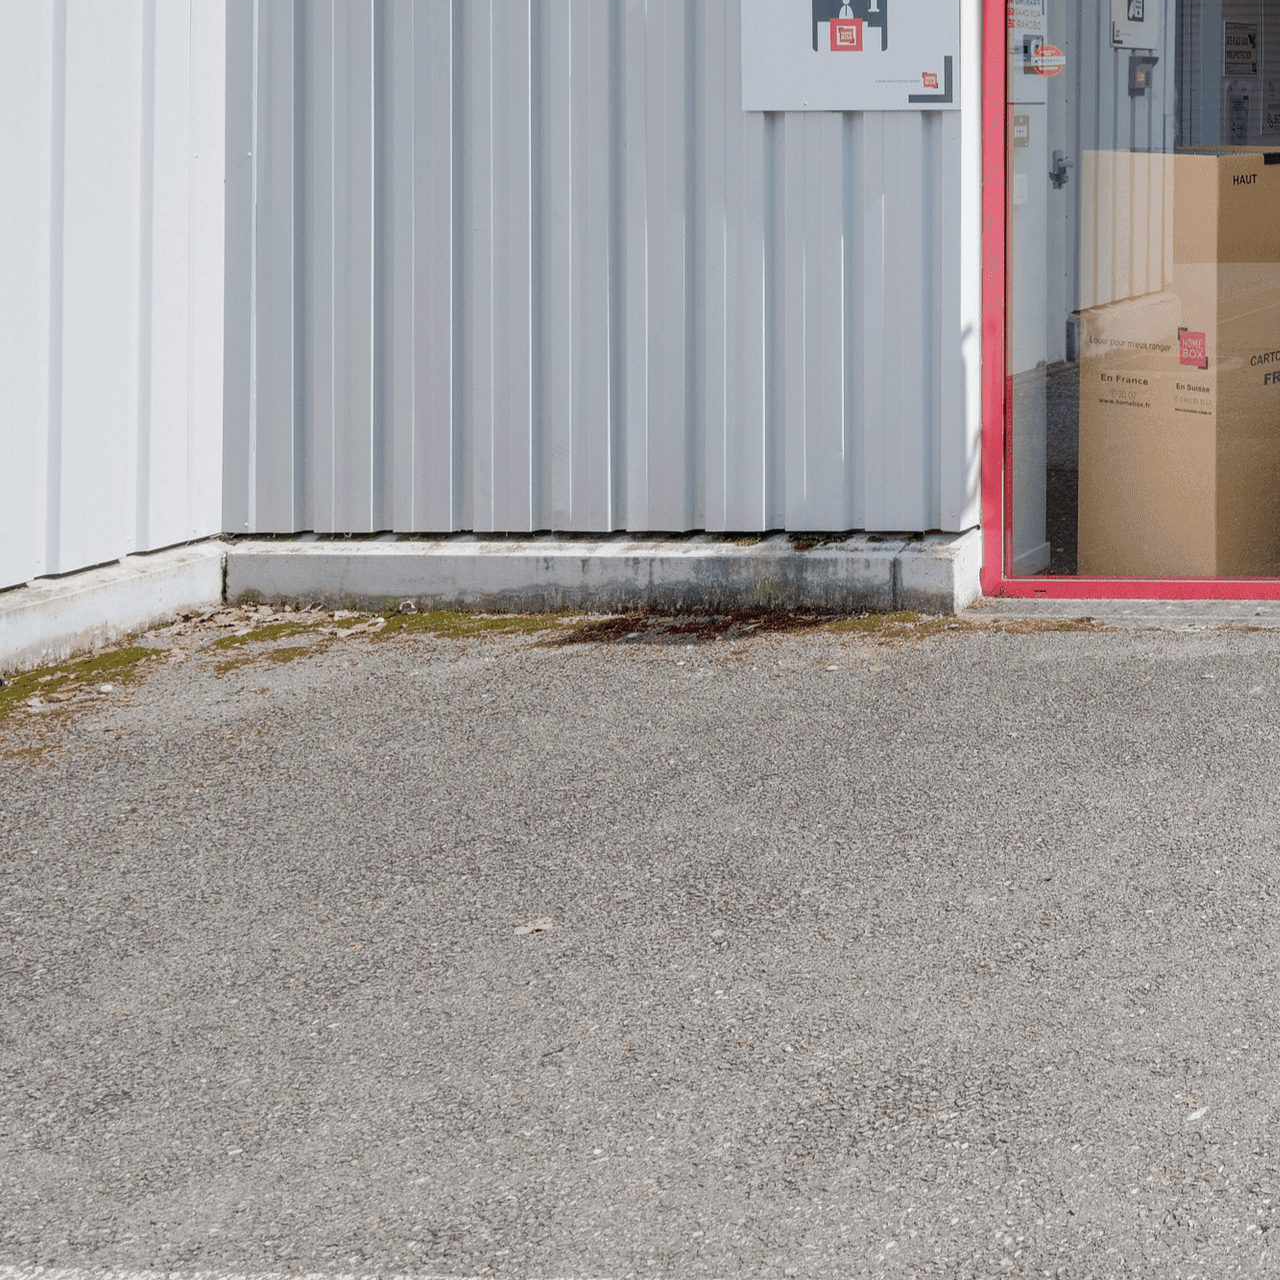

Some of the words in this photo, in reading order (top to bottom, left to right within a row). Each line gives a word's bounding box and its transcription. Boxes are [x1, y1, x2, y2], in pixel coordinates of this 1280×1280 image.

[1233, 174, 1257, 185] HAUT
[1089, 336, 1108, 345] Louer
[1110, 339, 1126, 348] pour
[1127, 340, 1148, 349] mieux
[1149, 343, 1171, 352] ranger
[1182, 339, 1203, 349] HOME
[1182, 348, 1203, 359] BOX
[1100, 374, 1113, 382] En
[1116, 375, 1149, 386] France
[1187, 384, 1210, 393] Suisse
[1128, 391, 1137, 400] 07
[1099, 398, 1150, 408] www.homebox.fr
